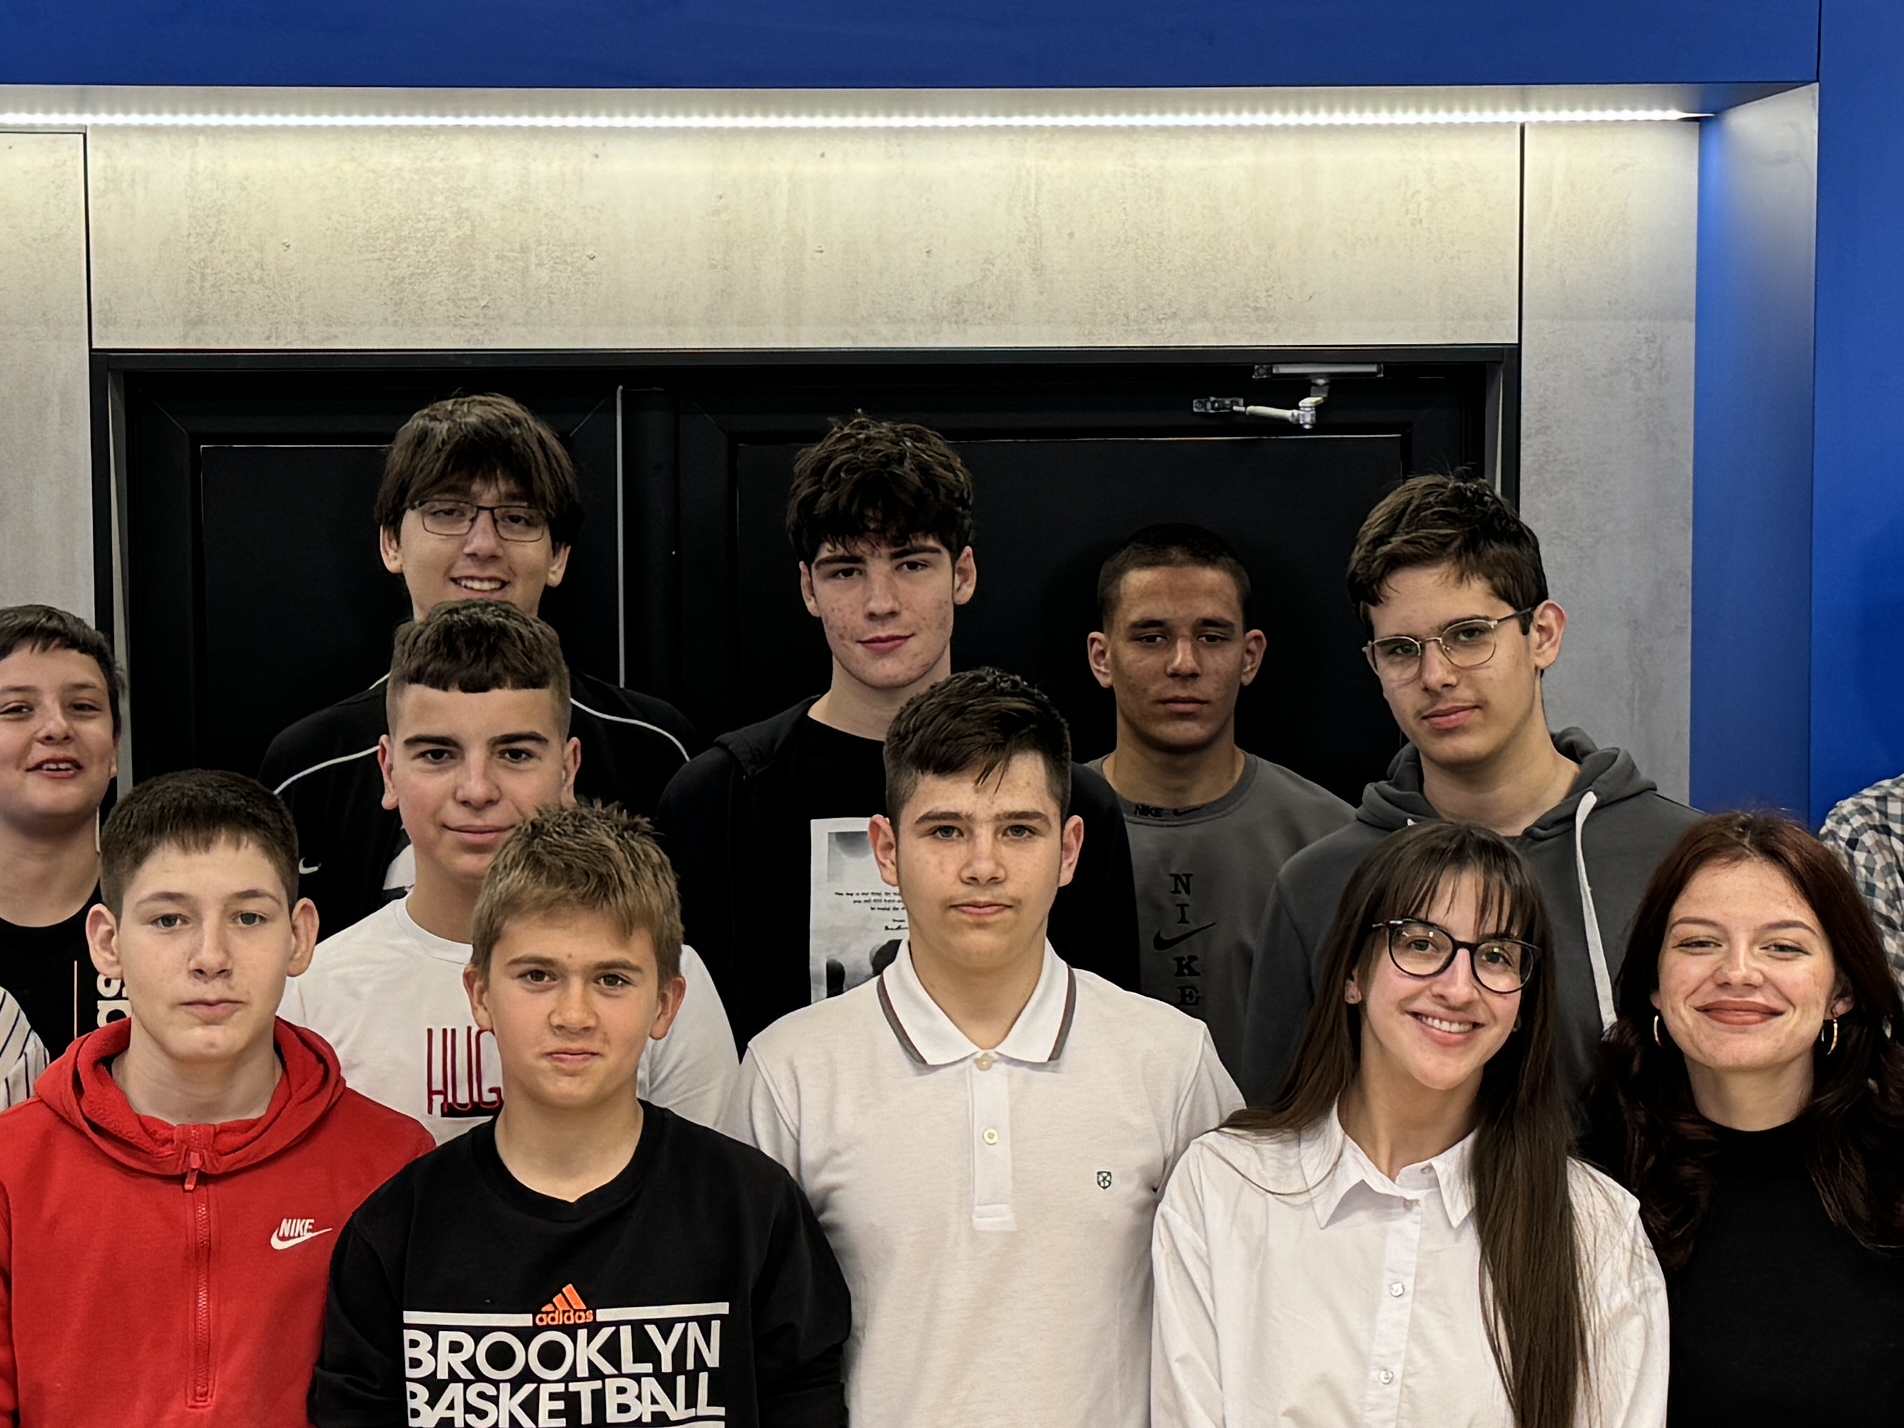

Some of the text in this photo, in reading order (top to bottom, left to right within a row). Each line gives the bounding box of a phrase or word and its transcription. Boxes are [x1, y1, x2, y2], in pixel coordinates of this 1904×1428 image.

[426, 1026, 505, 1115] HUG
[278, 1218, 315, 1237] NIKE
[535, 1307, 594, 1326] adidas
[403, 1319, 721, 1380] BROOKLYN
[405, 1371, 726, 1428] BASKETBALL
